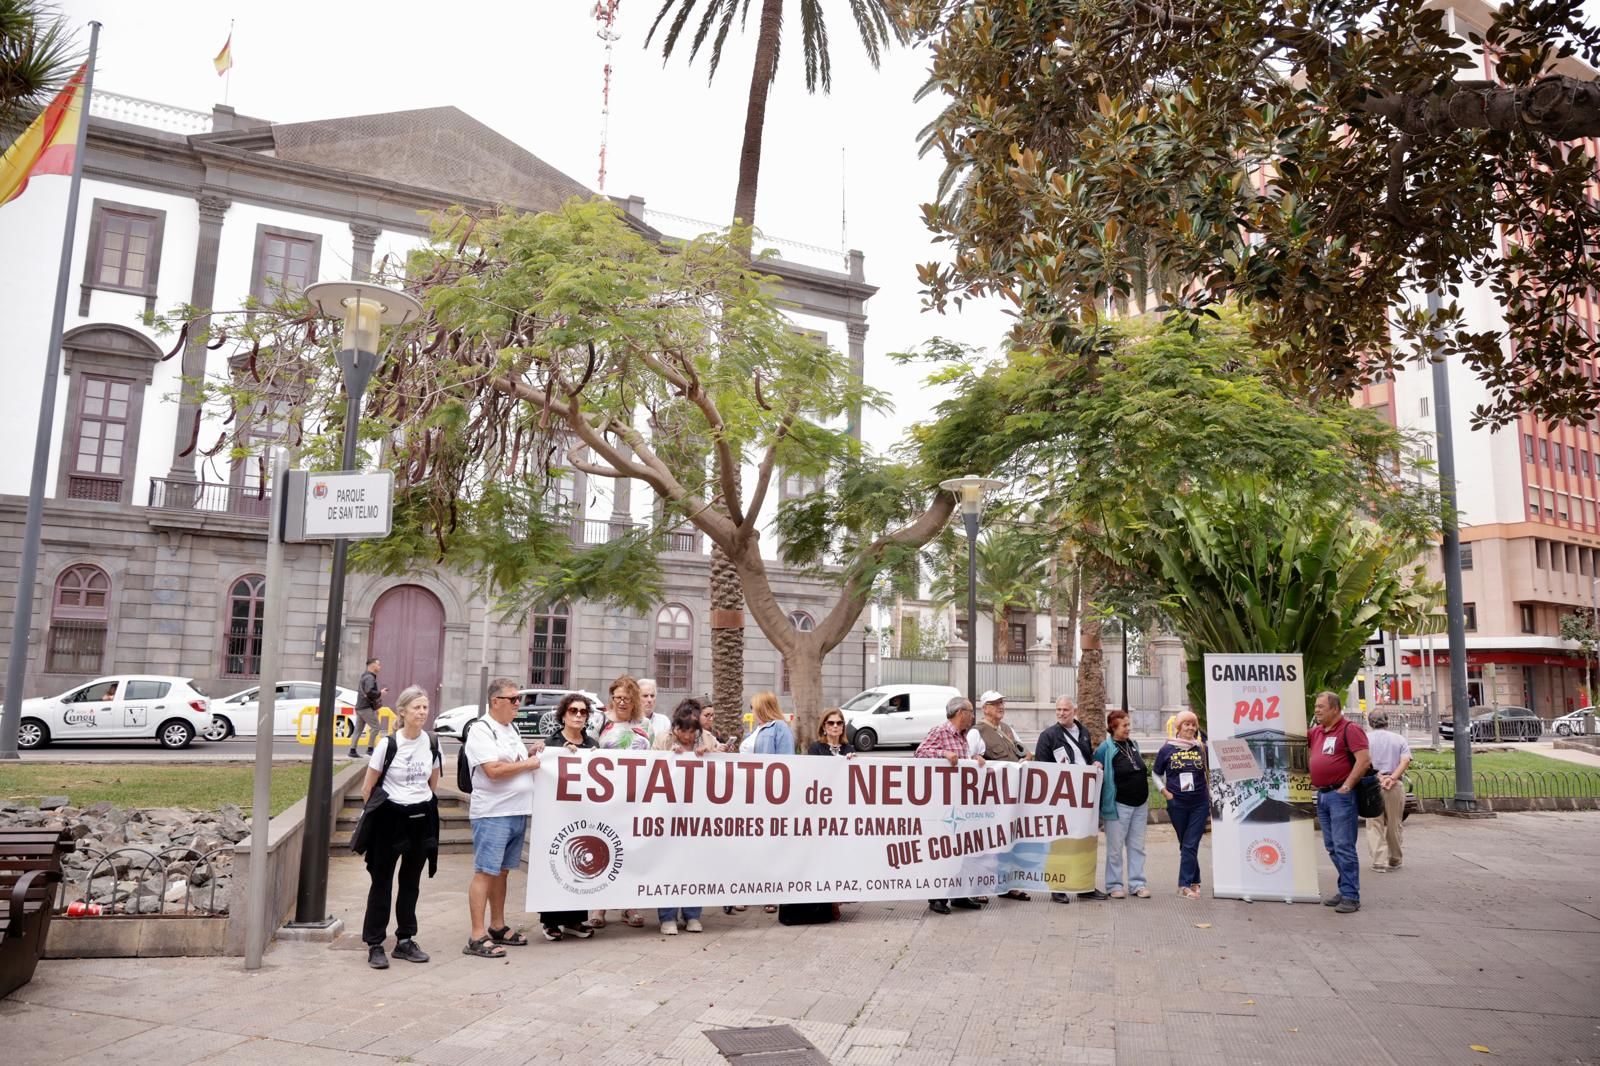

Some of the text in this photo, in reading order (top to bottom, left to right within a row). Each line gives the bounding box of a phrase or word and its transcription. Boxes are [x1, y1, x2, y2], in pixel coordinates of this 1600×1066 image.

[337, 489, 365, 503] PARQUE
[328, 505, 379, 520] DE SAN TELMO
[1212, 664, 1297, 681] CANARIAS
[1243, 686, 1268, 694] POR LA
[64, 709, 97, 728] Caney
[1233, 695, 1280, 725] PAZ
[556, 756, 791, 805] ESTATUTO
[805, 780, 833, 805] de
[965, 811, 984, 819] OTAN
[632, 817, 923, 837] LOS INVASORES DE LA PAZ CANARIA
[549, 819, 587, 855] ESTATUTO
[596, 822, 624, 882] NEUTRALIDAD
[886, 840, 923, 869] QUE
[928, 829, 984, 861] COJAN
[987, 824, 1006, 849] LA
[638, 883, 725, 896] PLATAFORMA
[730, 881, 784, 895] CANARIA
[788, 881, 812, 892] POR
[816, 880, 831, 892] LA
[836, 880, 862, 892] PAZ,
[866, 879, 912, 890] CONTRA
[916, 878, 930, 889] LA
[934, 877, 962, 888] OTAN
[969, 877, 975, 886] Y
[978, 875, 995, 885] POR
[998, 873, 1008, 885] LA
